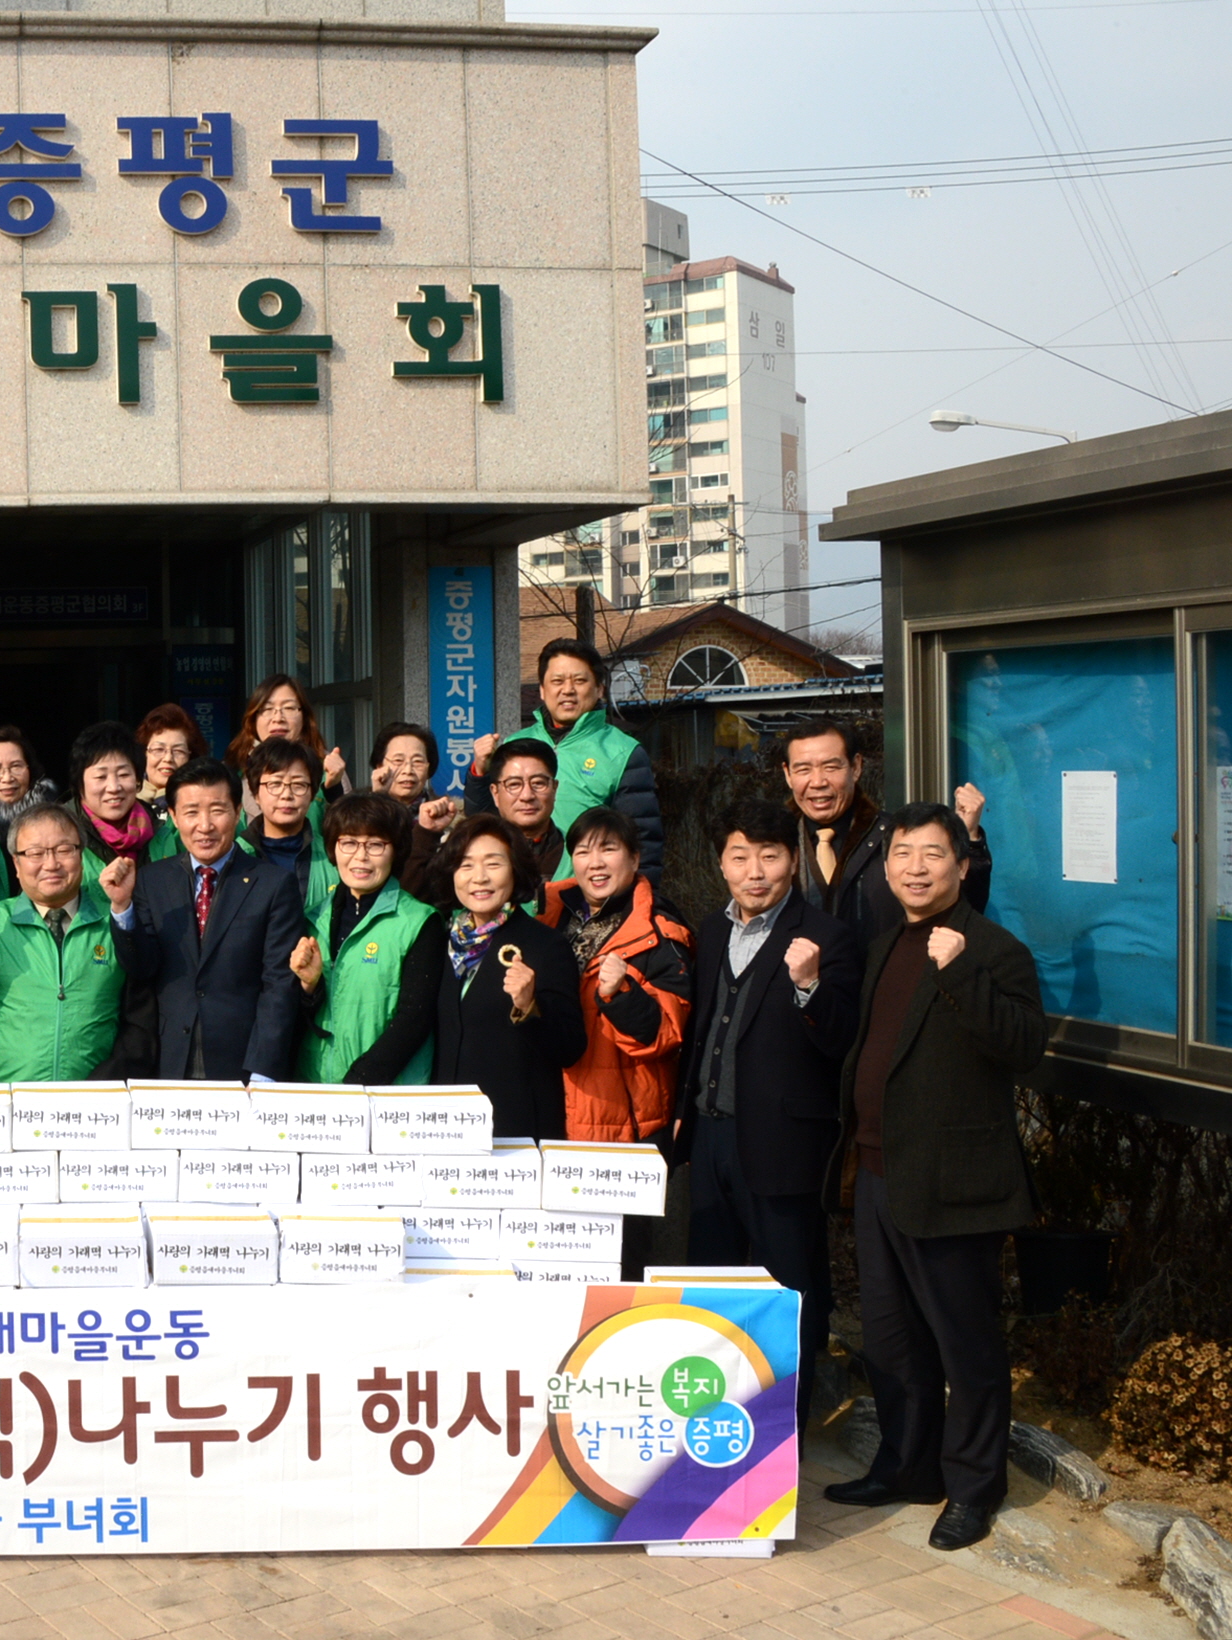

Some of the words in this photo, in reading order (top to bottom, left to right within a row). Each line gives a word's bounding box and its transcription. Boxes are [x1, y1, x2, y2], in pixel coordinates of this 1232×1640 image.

[13, 1111, 43, 1123] 사랑의
[50, 1111, 81, 1124] 가래떡
[88, 1113, 119, 1125] 나누기
[134, 1108, 164, 1120] 사랑의
[170, 1109, 202, 1121] 가래떡
[208, 1110, 240, 1122] 나누기
[256, 1113, 288, 1125] 사랑의
[294, 1114, 326, 1126] 가래떡
[332, 1115, 364, 1127] 나누기
[378, 1111, 409, 1124] 사랑의
[416, 1112, 448, 1124] 가래떡
[454, 1113, 486, 1125] 나누기
[19, 1165, 50, 1177] 나누기
[60, 1165, 91, 1176] 사랑의
[97, 1165, 129, 1176] 가래떡
[135, 1166, 166, 1177] 나누기
[184, 1162, 215, 1175] 사랑의
[221, 1163, 253, 1174] 가래떡
[259, 1163, 290, 1175] 나누기
[309, 1164, 339, 1177] 사랑의
[346, 1162, 377, 1174] 가래떡
[384, 1160, 415, 1172] 나누기
[428, 1168, 459, 1180] 사랑의
[466, 1169, 498, 1181] 가래떡
[504, 1169, 536, 1181] 나누기
[550, 1166, 583, 1179] 사랑의
[589, 1168, 622, 1182] 가래떡
[628, 1171, 660, 1185] 나누기
[423, 1218, 454, 1230] 가래떡
[460, 1218, 492, 1230] 나누기
[505, 1221, 537, 1234] 사랑의
[544, 1222, 576, 1234] 가래떡
[582, 1223, 614, 1235] 나누기
[29, 1246, 62, 1259] 사랑의
[68, 1246, 101, 1258] 가래떡
[108, 1246, 140, 1258] 나누기
[157, 1245, 190, 1258] 사랑의
[197, 1246, 230, 1259] 가래떡
[236, 1247, 269, 1260] 나누기
[289, 1242, 322, 1255] 사랑의
[328, 1243, 361, 1256] 가래떡
[367, 1244, 401, 1257] 나누기
[547, 1375, 655, 1409] 앞서가는
[672, 1368, 719, 1408] 복지
[357, 1367, 534, 1477] 행사
[577, 1415, 675, 1461] 살기좋은
[692, 1417, 744, 1455] 증평
[17, 1499, 149, 1544] 부녀회
